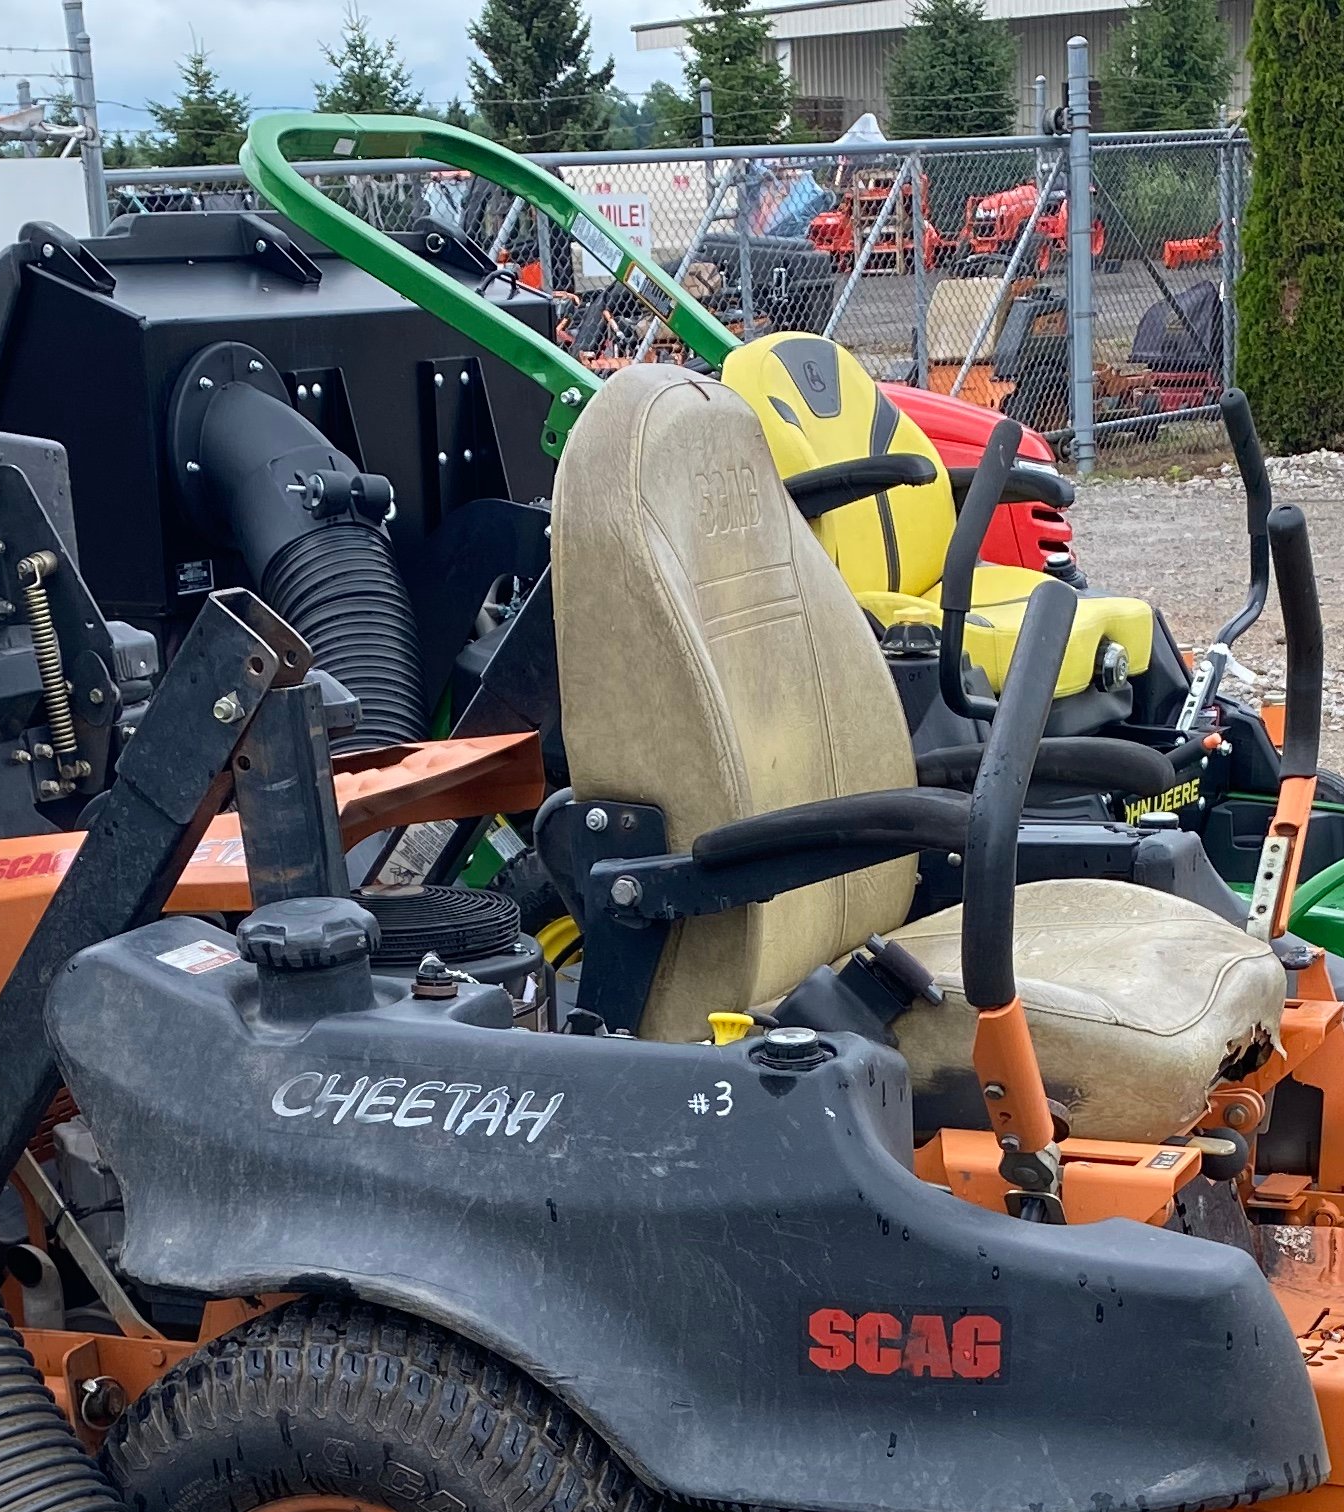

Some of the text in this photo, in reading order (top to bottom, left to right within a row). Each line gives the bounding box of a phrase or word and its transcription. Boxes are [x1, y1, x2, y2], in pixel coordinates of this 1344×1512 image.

[1153, 777, 1200, 813] DEERE
[271, 1071, 565, 1143] CHEETAH
[687, 1080, 733, 1116] #3
[808, 1307, 1002, 1379] SCAG
